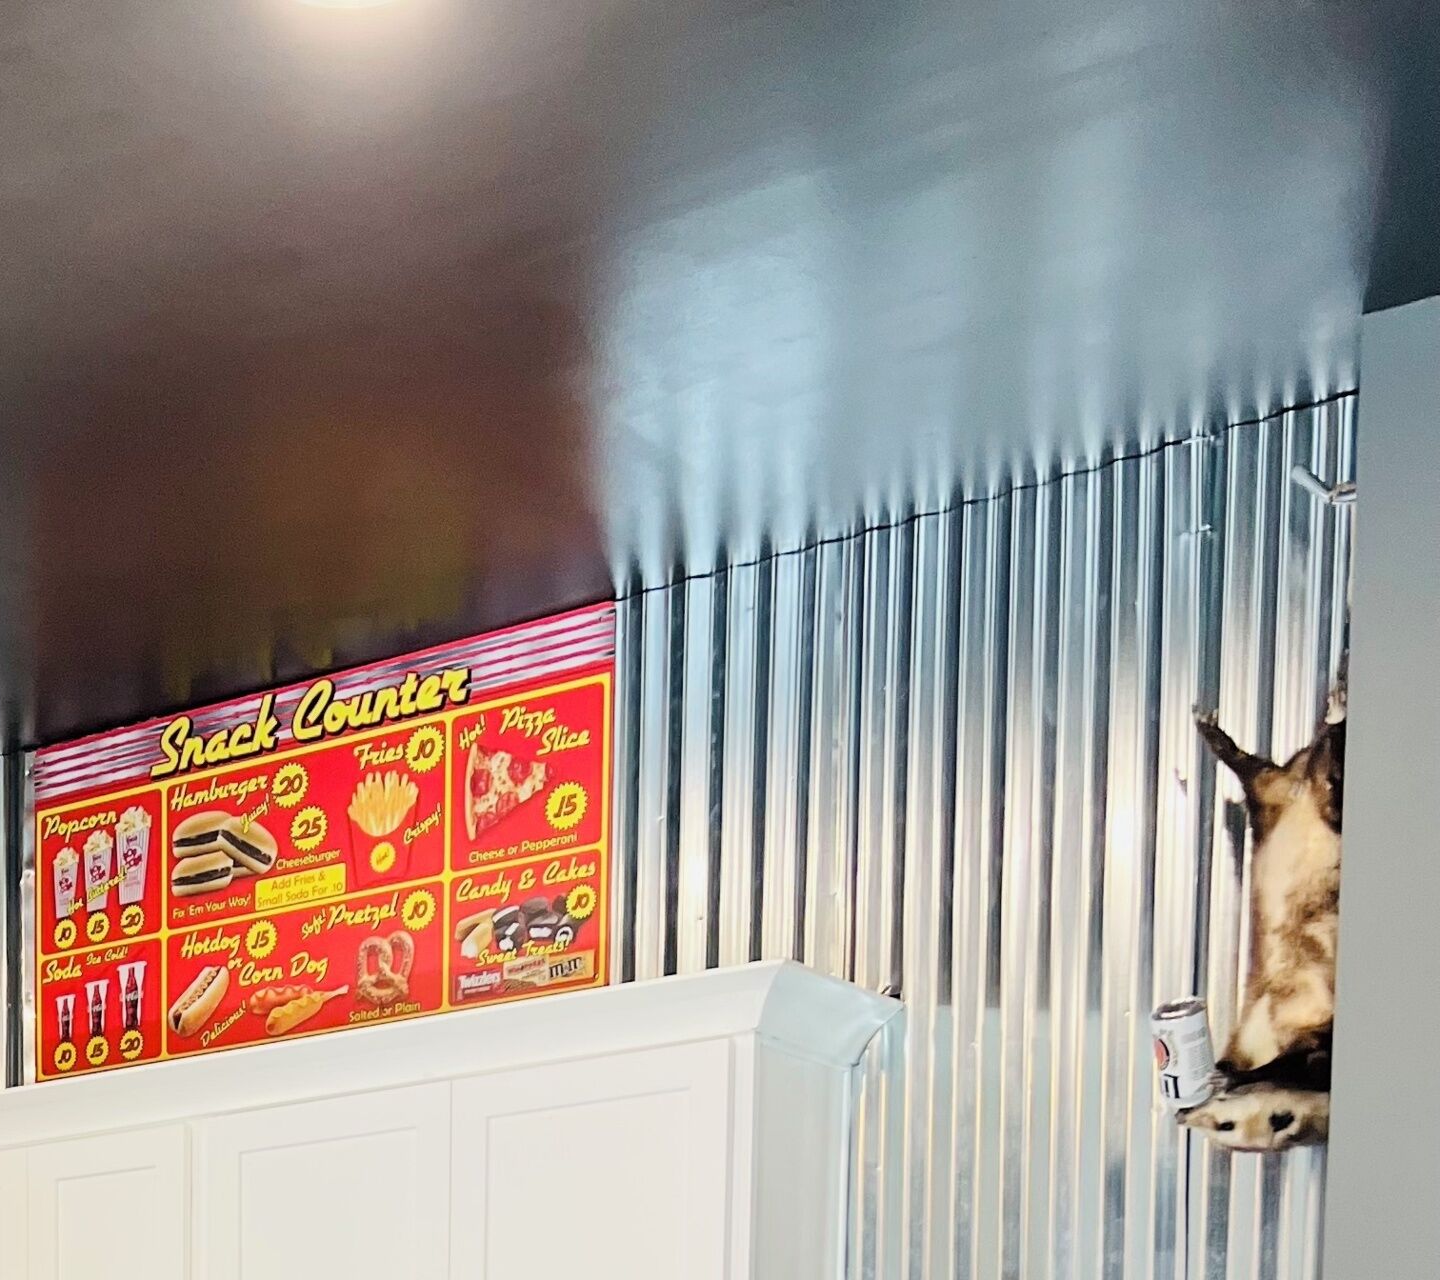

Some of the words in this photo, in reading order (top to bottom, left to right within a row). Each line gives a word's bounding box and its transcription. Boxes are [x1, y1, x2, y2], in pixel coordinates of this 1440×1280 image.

[150, 695, 278, 777] Snack
[292, 667, 470, 741] Counter
[499, 706, 556, 738] Pizza
[353, 741, 404, 770] Fries
[536, 725, 590, 756] Slice
[171, 776, 269, 812] Hamburger
[43, 811, 117, 843] Popcorn
[403, 802, 442, 845] Crispy!
[276, 849, 342, 871] Cheeseburger
[468, 848, 505, 864] Cheese
[508, 845, 519, 855] or
[521, 832, 578, 852] Pepperoni
[257, 894, 283, 909] Small
[286, 887, 309, 900] Soda
[312, 884, 329, 896] For
[271, 880, 291, 891] Add
[294, 874, 315, 887] Fries
[318, 870, 327, 882] &
[456, 872, 513, 904] Candy
[518, 868, 537, 890] &
[542, 857, 596, 885] Cakes
[205, 899, 227, 913] Your
[327, 891, 400, 930] Pretzel
[180, 927, 241, 959] Hotdog
[475, 948, 518, 967] Sweet
[42, 956, 82, 984] Soda
[227, 956, 243, 970] or
[238, 961, 284, 987] Corn
[289, 951, 329, 983] Dog
[200, 1000, 247, 1048] Delicious!
[349, 1007, 380, 1023] Salted
[394, 1001, 421, 1014] Plain
